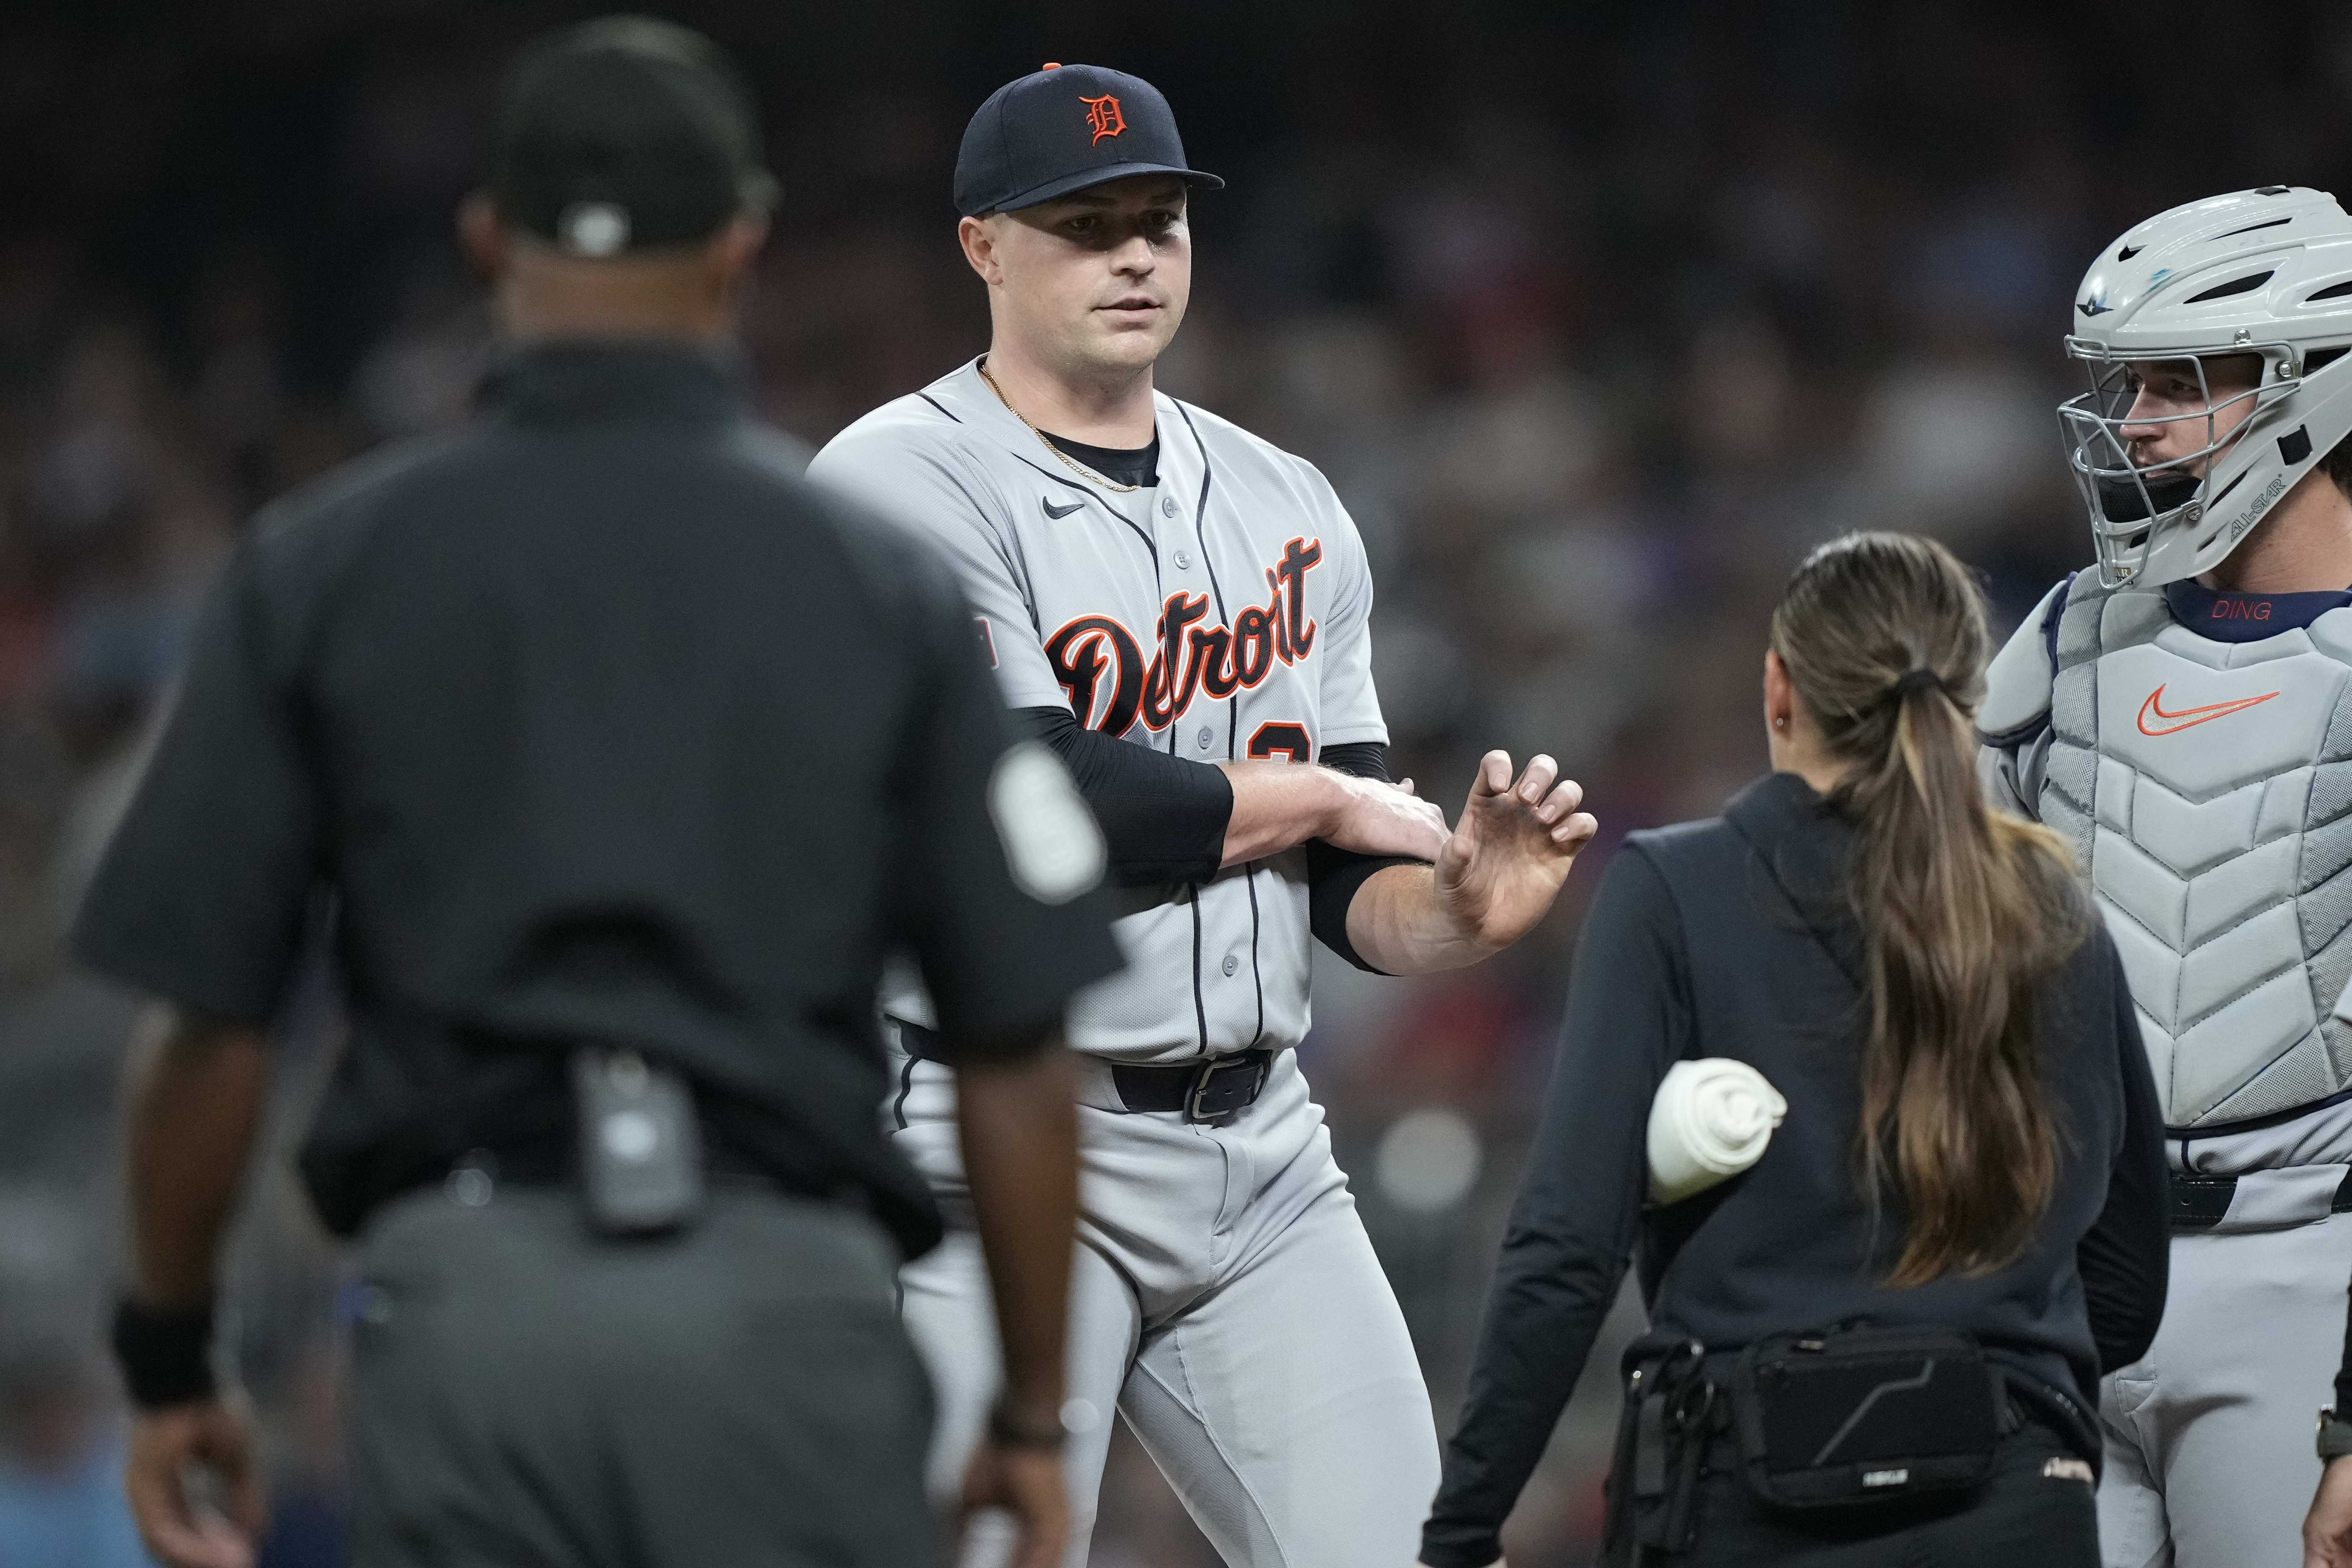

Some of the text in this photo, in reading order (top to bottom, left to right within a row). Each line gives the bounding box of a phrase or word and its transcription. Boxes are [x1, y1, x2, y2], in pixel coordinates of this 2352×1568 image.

[1078, 94, 1127, 147] D
[2231, 479, 2286, 543] ALL-STAR
[1042, 535, 1323, 740] Detroit
[2212, 600, 2272, 620] DING
